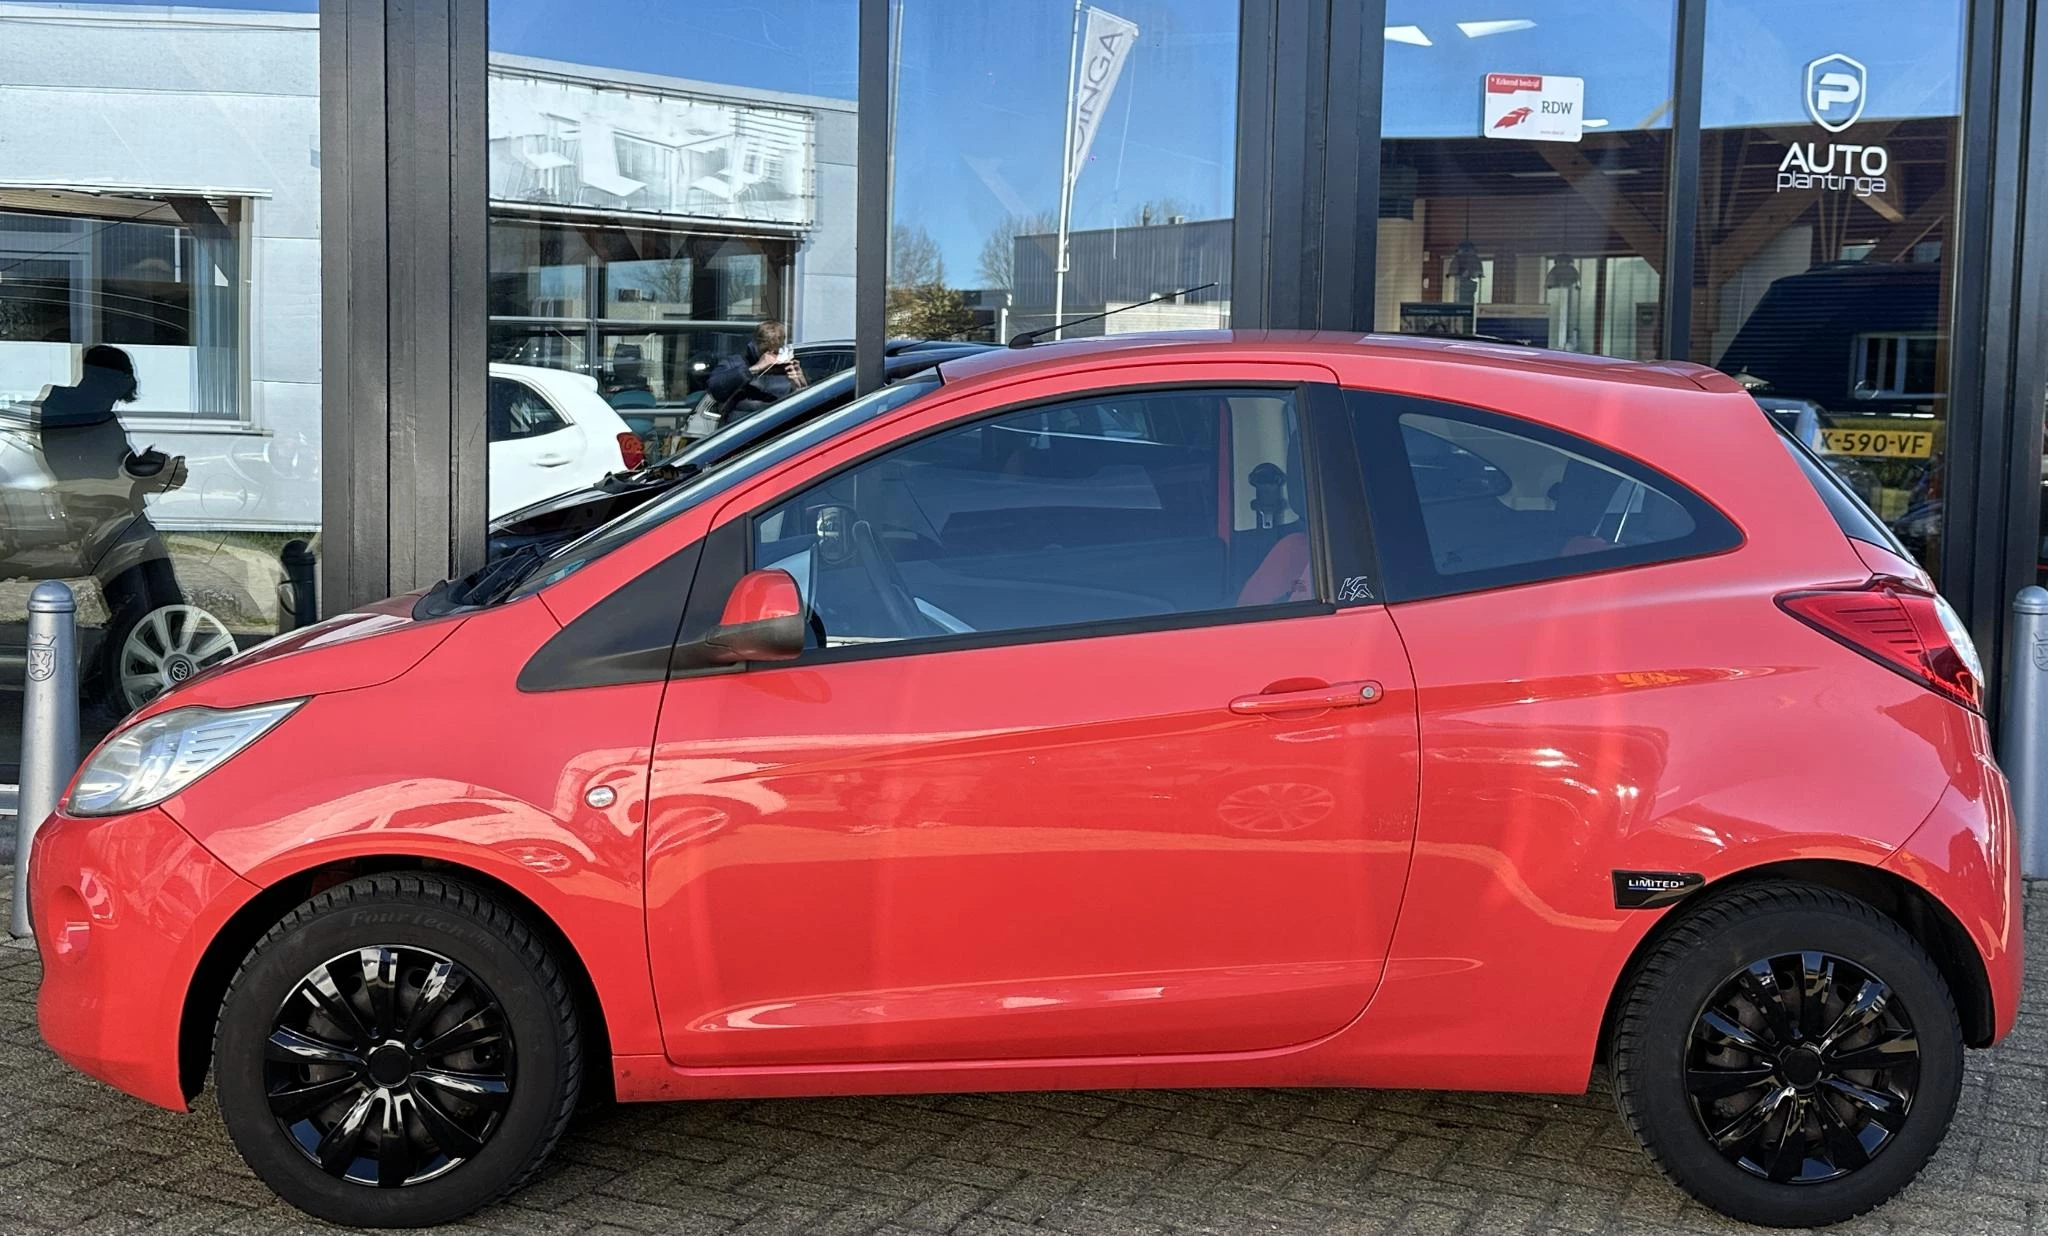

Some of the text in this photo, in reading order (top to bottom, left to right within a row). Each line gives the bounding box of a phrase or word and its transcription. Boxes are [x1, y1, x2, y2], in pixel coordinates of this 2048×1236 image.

[1541, 101, 1573, 115] RDW
[1778, 142, 1887, 176] AUTO
[1776, 171, 1887, 197] plantinga
